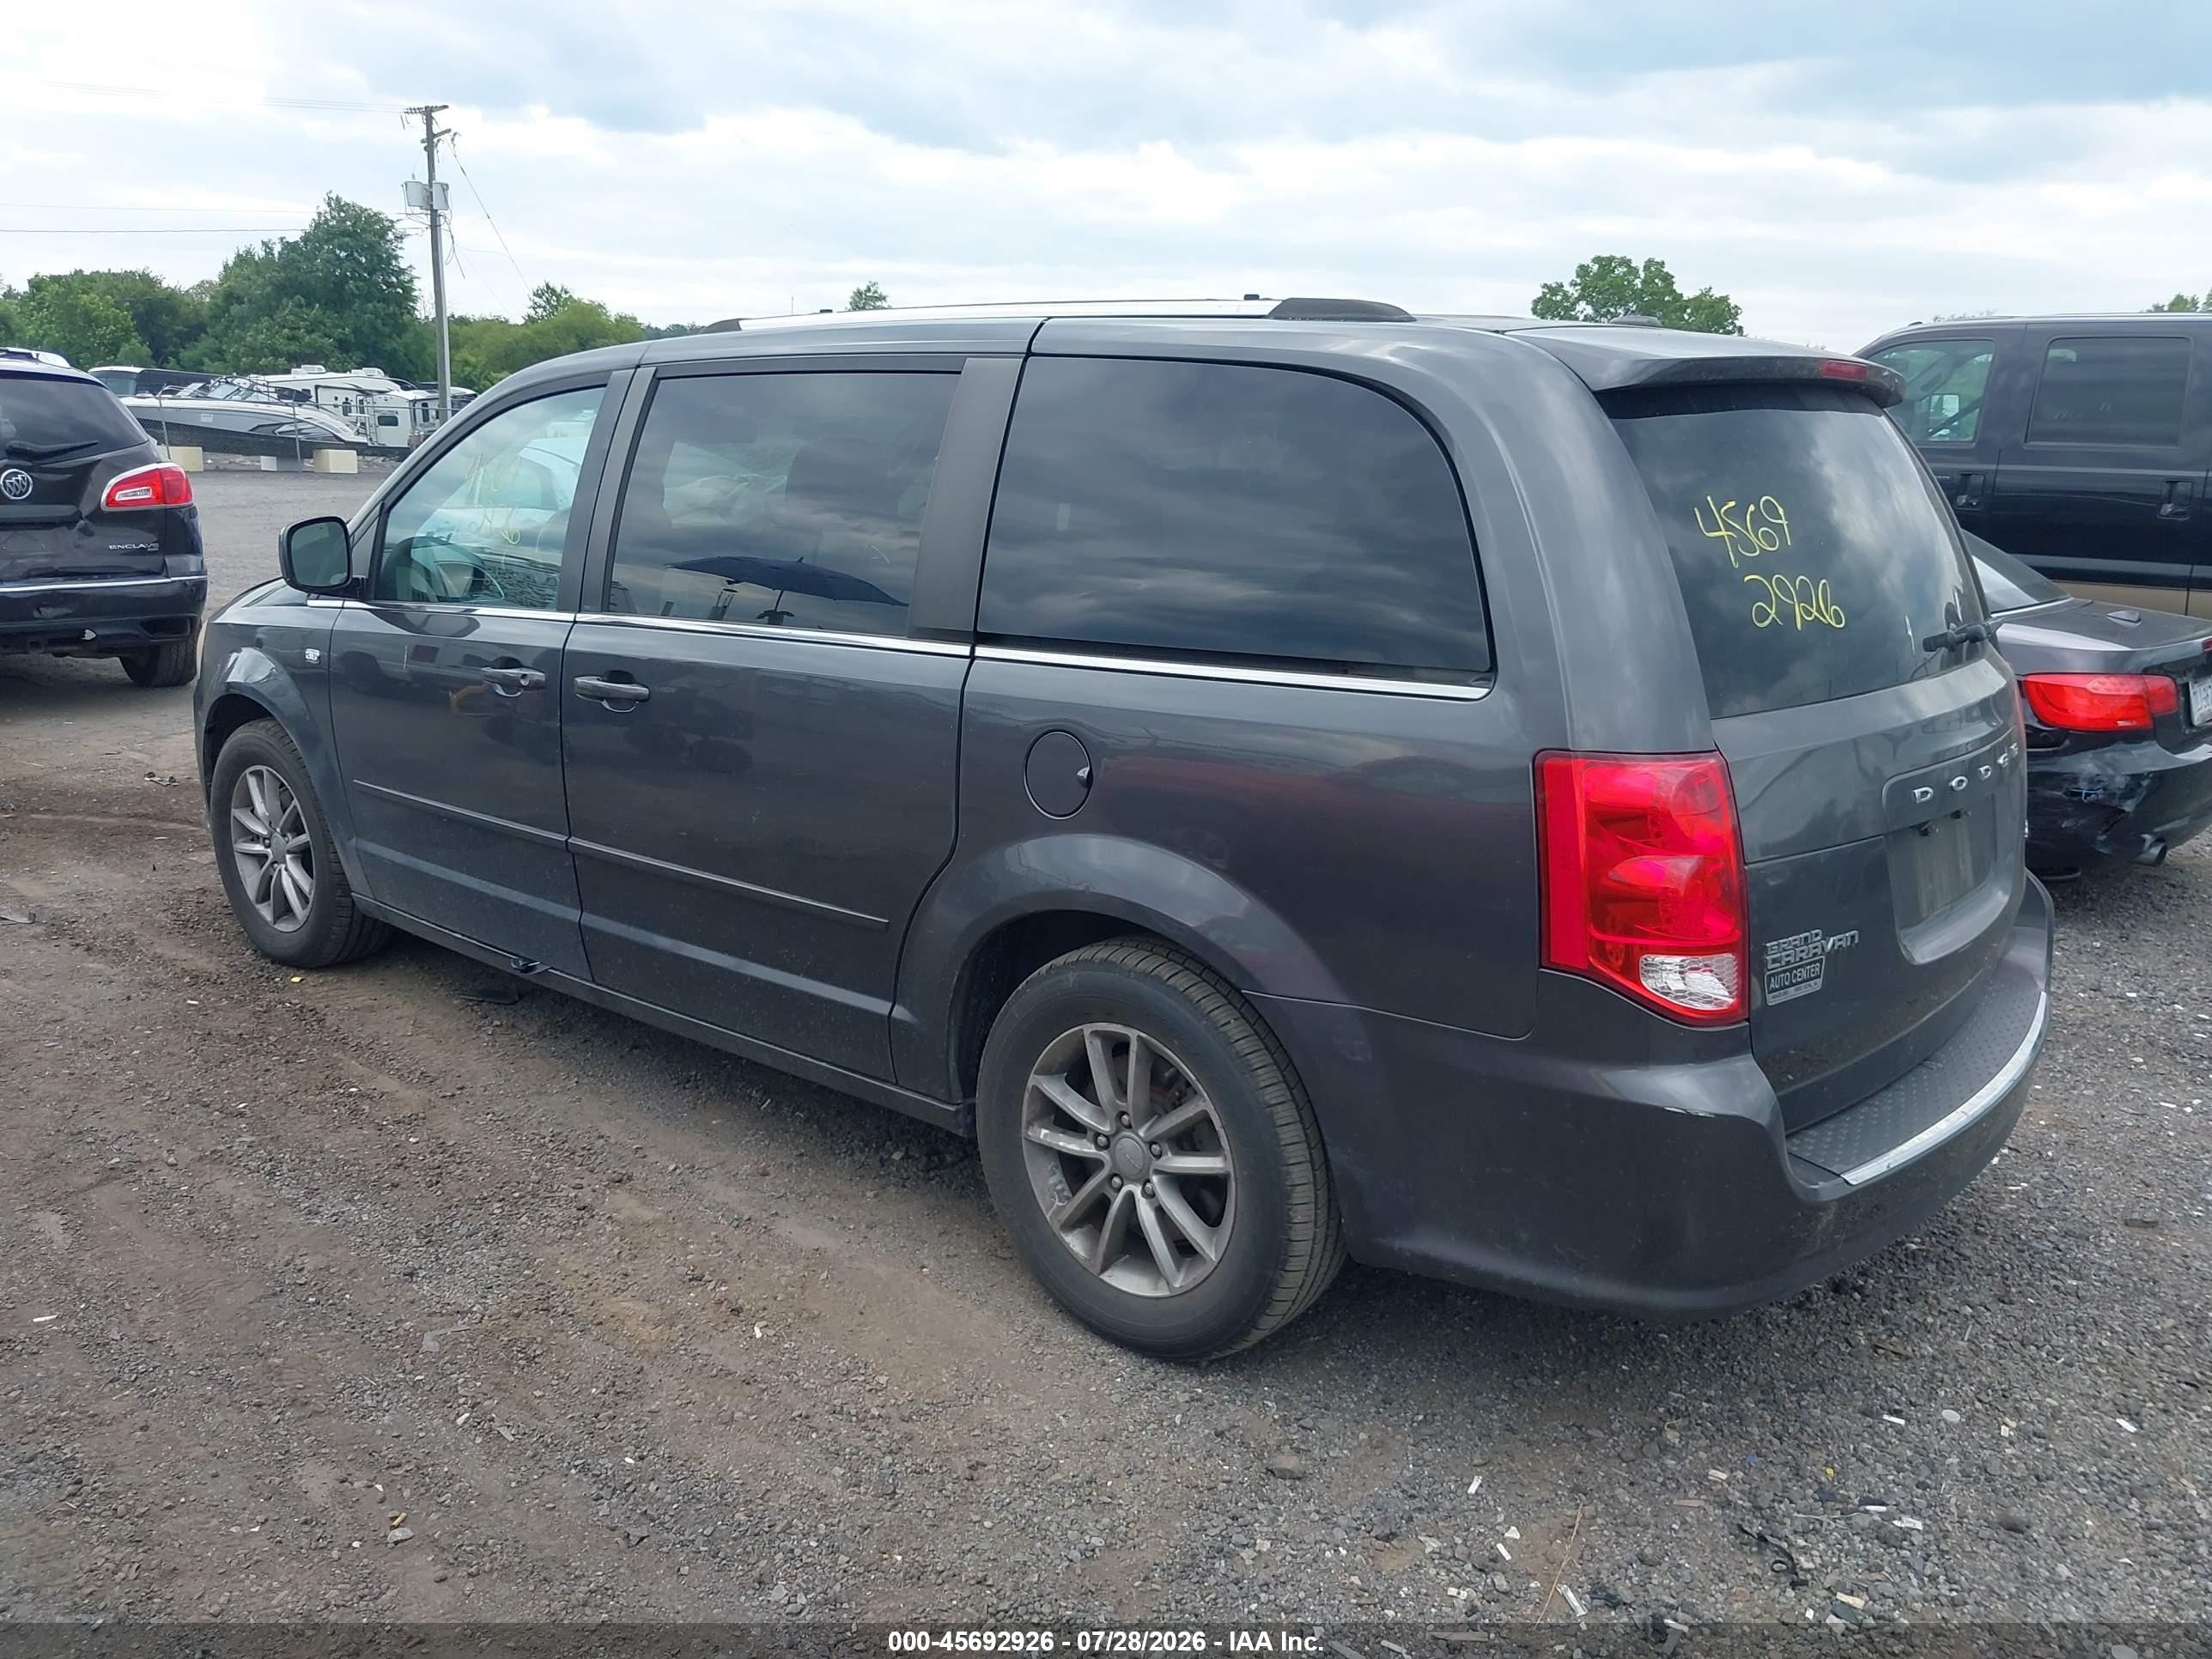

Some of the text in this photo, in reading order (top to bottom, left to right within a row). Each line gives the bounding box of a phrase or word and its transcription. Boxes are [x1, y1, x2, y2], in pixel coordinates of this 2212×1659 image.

[1693, 495, 1792, 568] 4569
[1743, 574, 1846, 631] 2926
[1765, 929, 1822, 955] GRAND
[1765, 930, 1859, 969] CARAVAN
[1770, 972, 1790, 990] AUTO
[1791, 963, 1820, 983] CENTER
